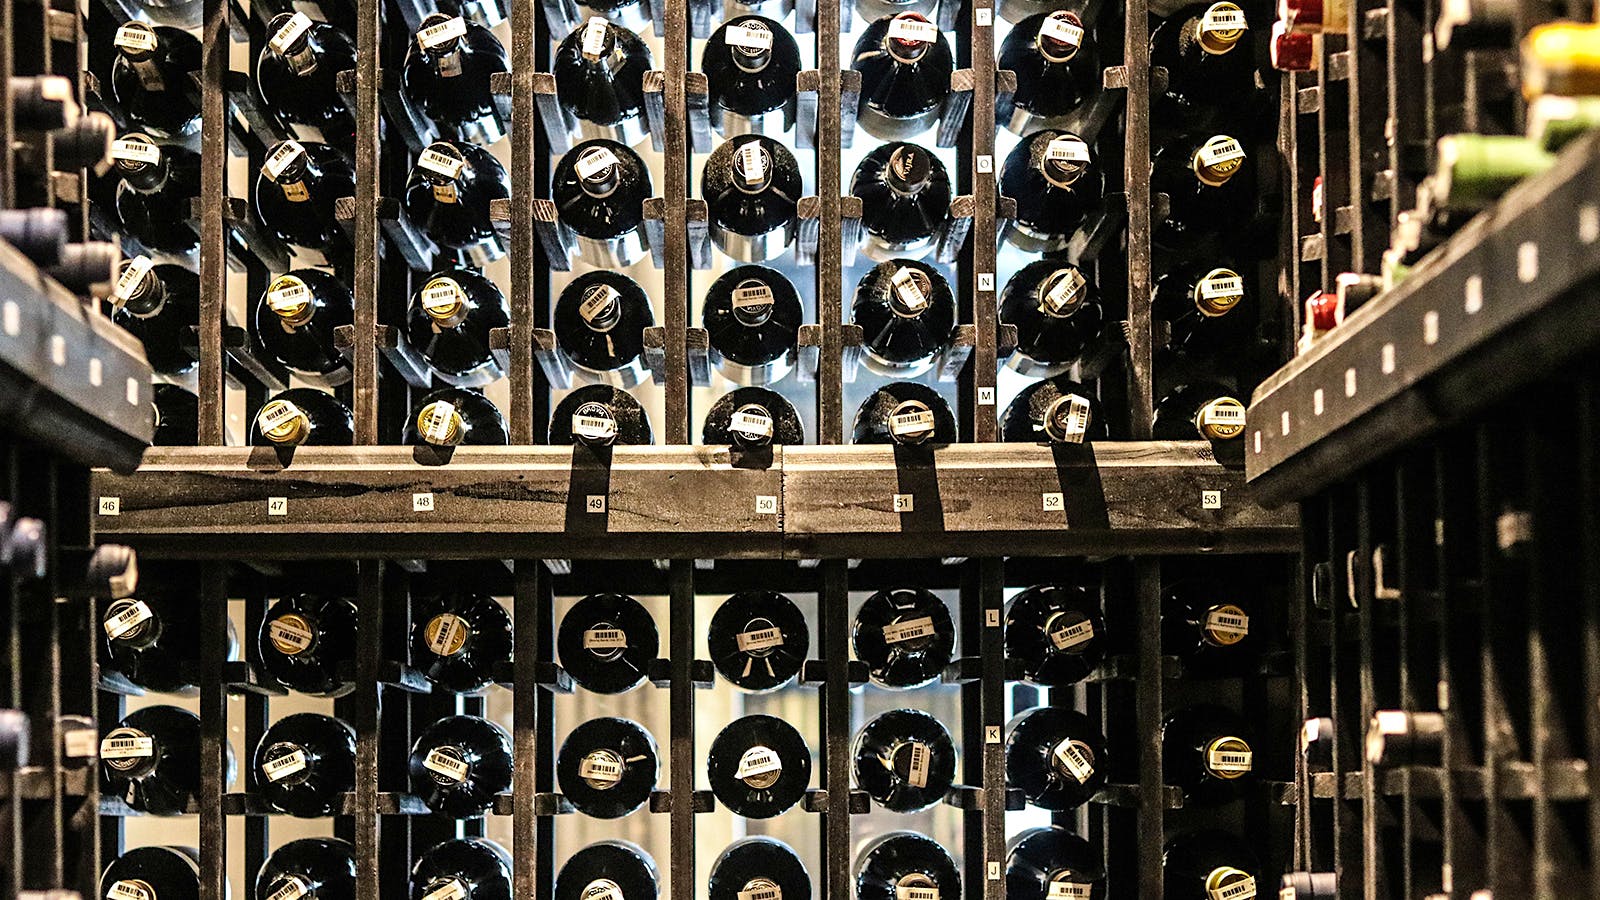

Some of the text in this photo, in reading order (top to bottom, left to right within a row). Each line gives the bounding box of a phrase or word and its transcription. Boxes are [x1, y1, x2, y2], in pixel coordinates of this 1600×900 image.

[980, 159, 989, 168] O
[982, 277, 990, 286] N
[981, 391, 991, 400] M
[416, 497, 430, 506] 48
[589, 498, 602, 509] 49
[759, 499, 773, 509] 50
[896, 498, 908, 508] 51
[1046, 496, 1059, 506] 52
[1204, 494, 1217, 504] 53
[102, 501, 115, 511] 46
[270, 501, 284, 511] 47
[989, 613, 997, 623] L
[989, 729, 998, 739] K
[990, 866, 997, 875] J
